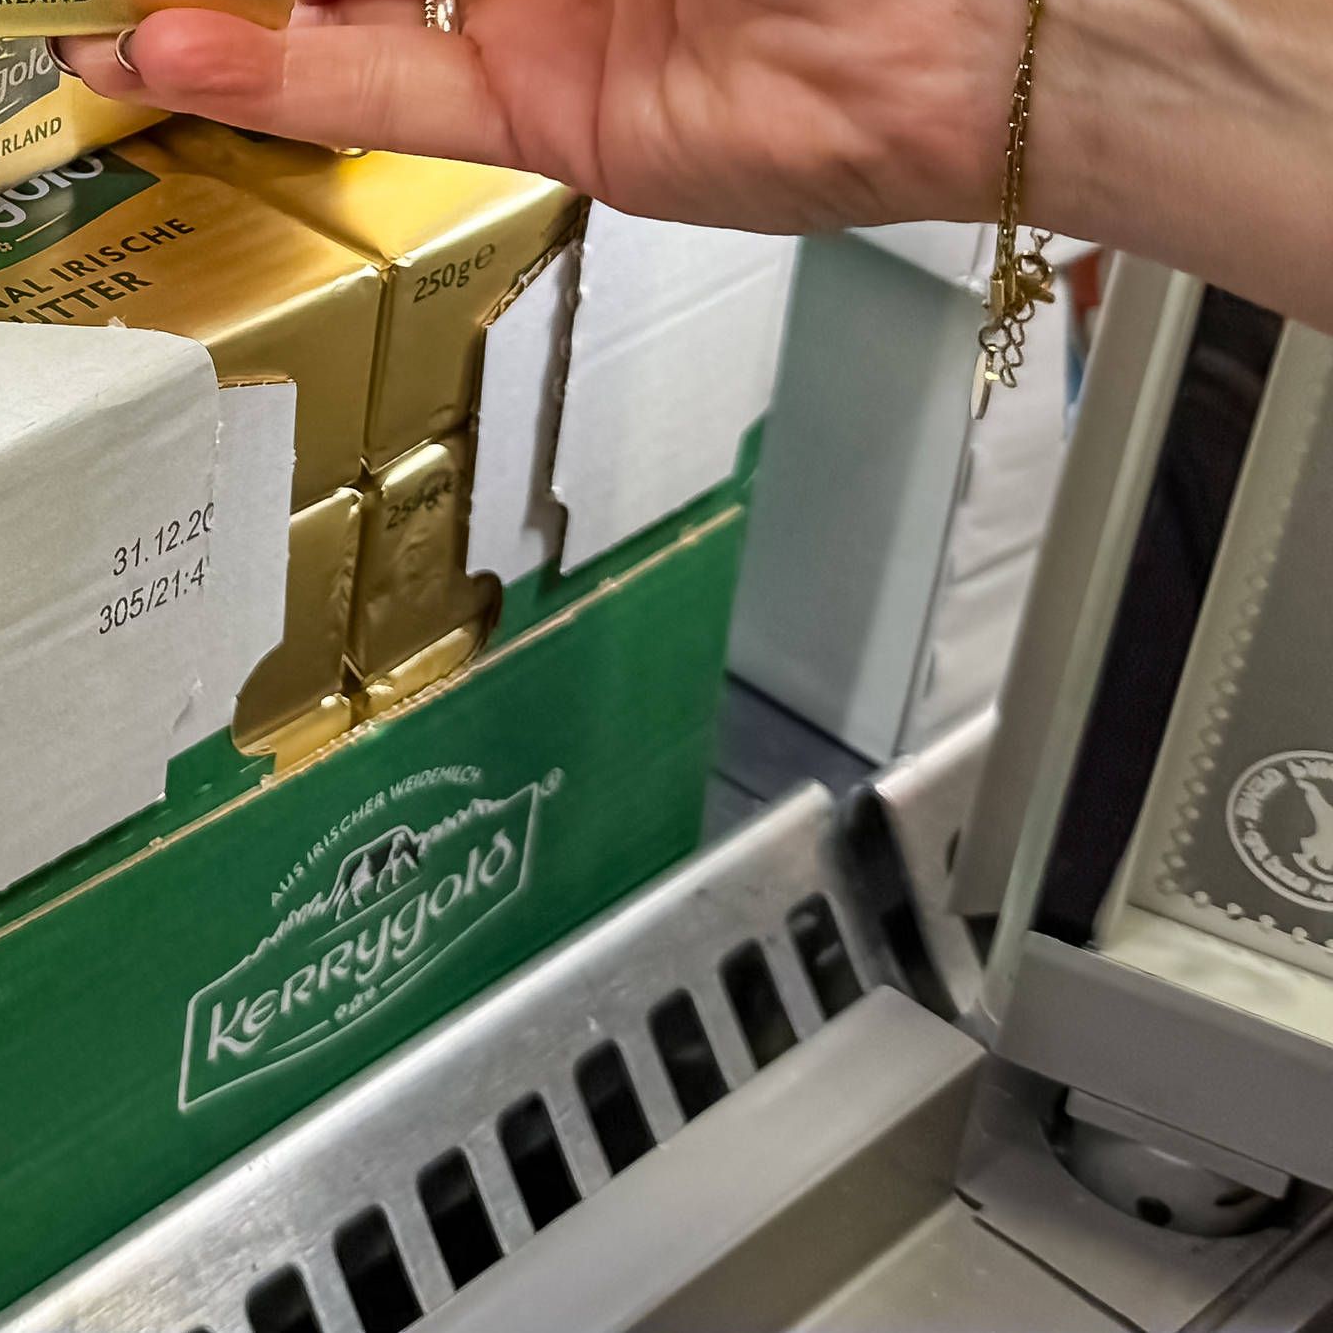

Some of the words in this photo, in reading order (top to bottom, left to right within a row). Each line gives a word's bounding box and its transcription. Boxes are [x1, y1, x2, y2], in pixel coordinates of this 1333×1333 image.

[50, 218, 195, 283] IRISCHE
[11, 271, 153, 325] UTTER
[271, 861, 304, 907] AUS
[307, 790, 386, 866] IRISCHER
[207, 828, 516, 1062] Kerrygold
